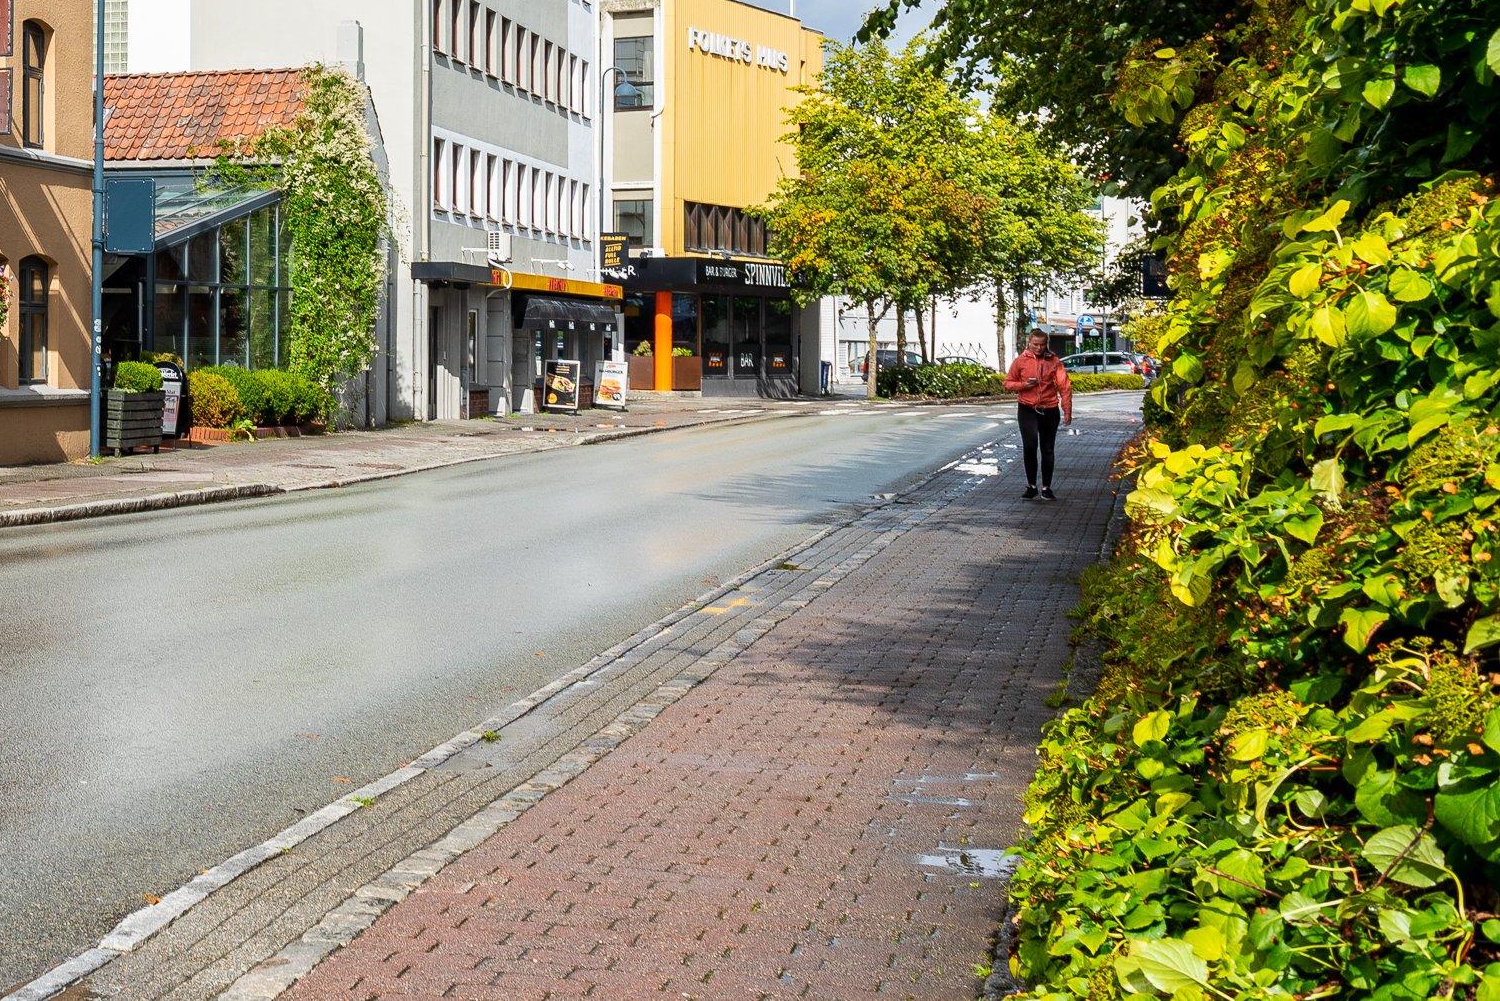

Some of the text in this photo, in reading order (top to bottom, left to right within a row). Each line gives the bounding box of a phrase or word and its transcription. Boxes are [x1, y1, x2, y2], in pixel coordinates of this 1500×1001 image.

[688, 26, 788, 72] FOLKETS HUS
[705, 265, 714, 276] BAR
